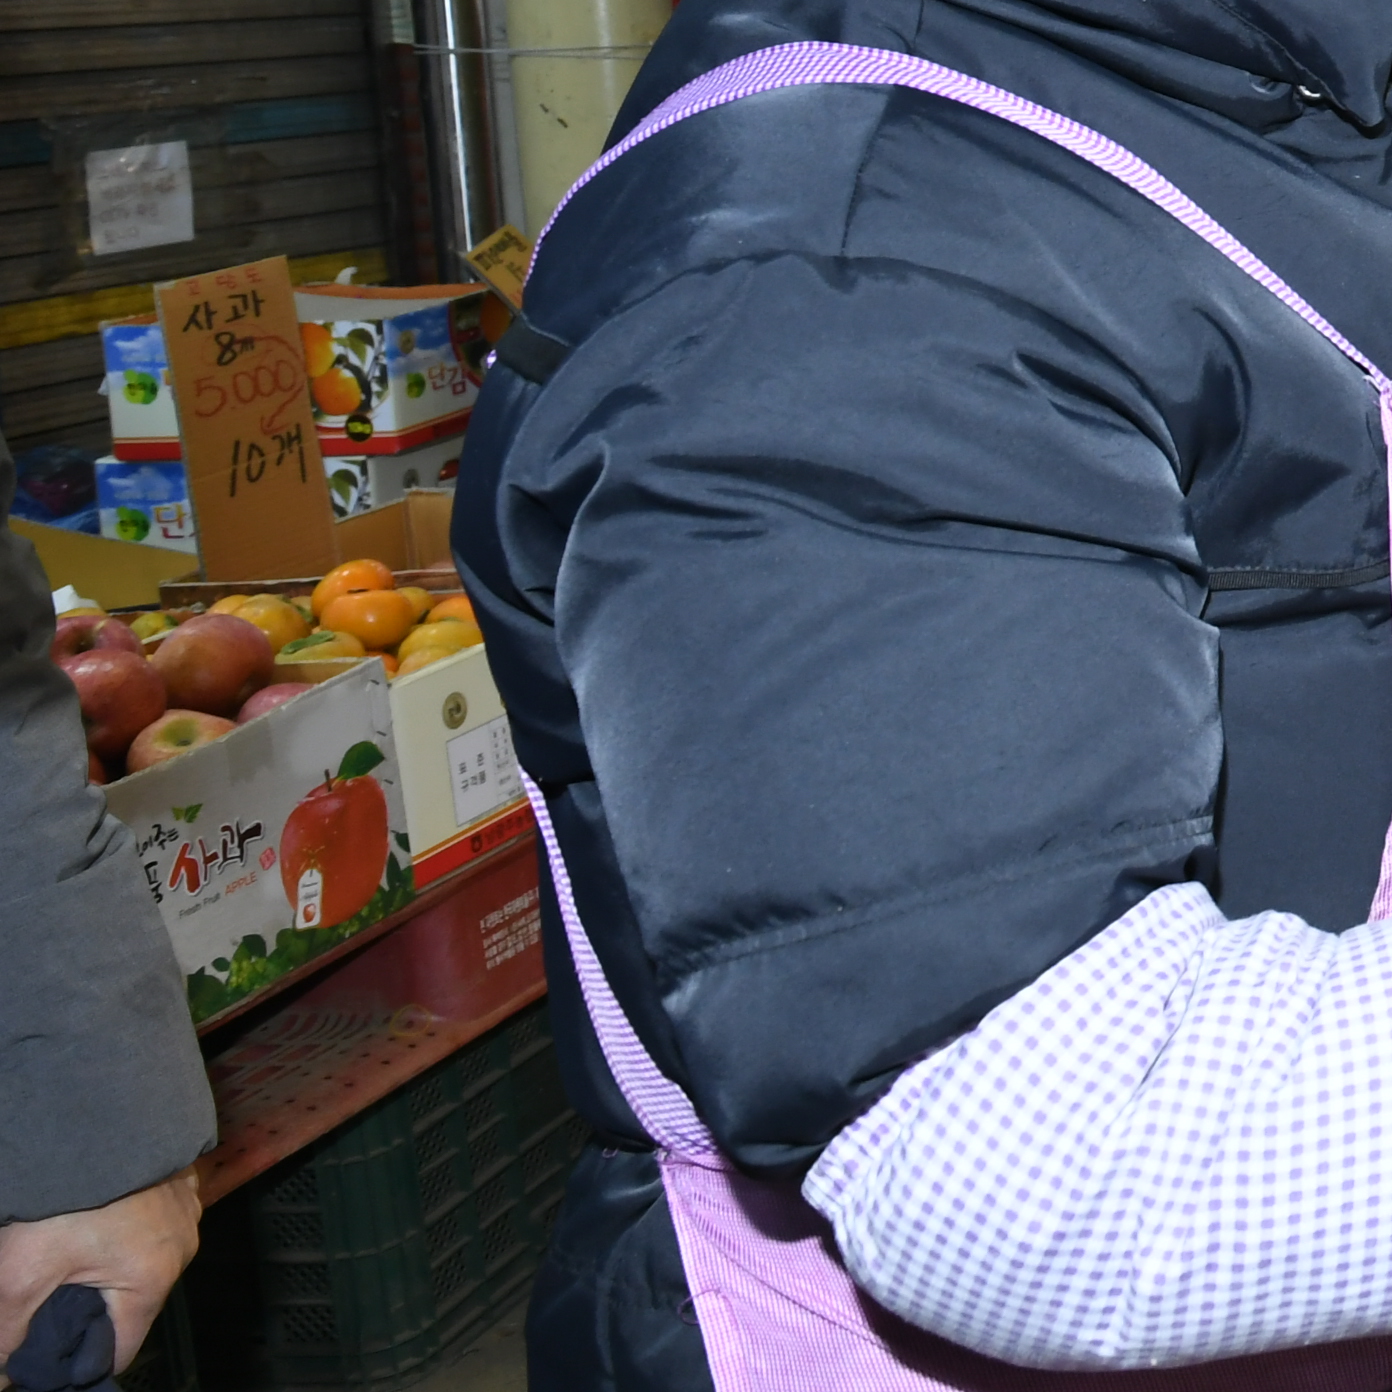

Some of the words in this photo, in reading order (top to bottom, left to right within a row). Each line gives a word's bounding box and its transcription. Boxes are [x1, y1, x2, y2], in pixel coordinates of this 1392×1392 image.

[183, 289, 265, 333] 사과
[427, 364, 468, 396] 단감
[168, 818, 262, 895] 사과
[224, 871, 257, 896] APPLE
